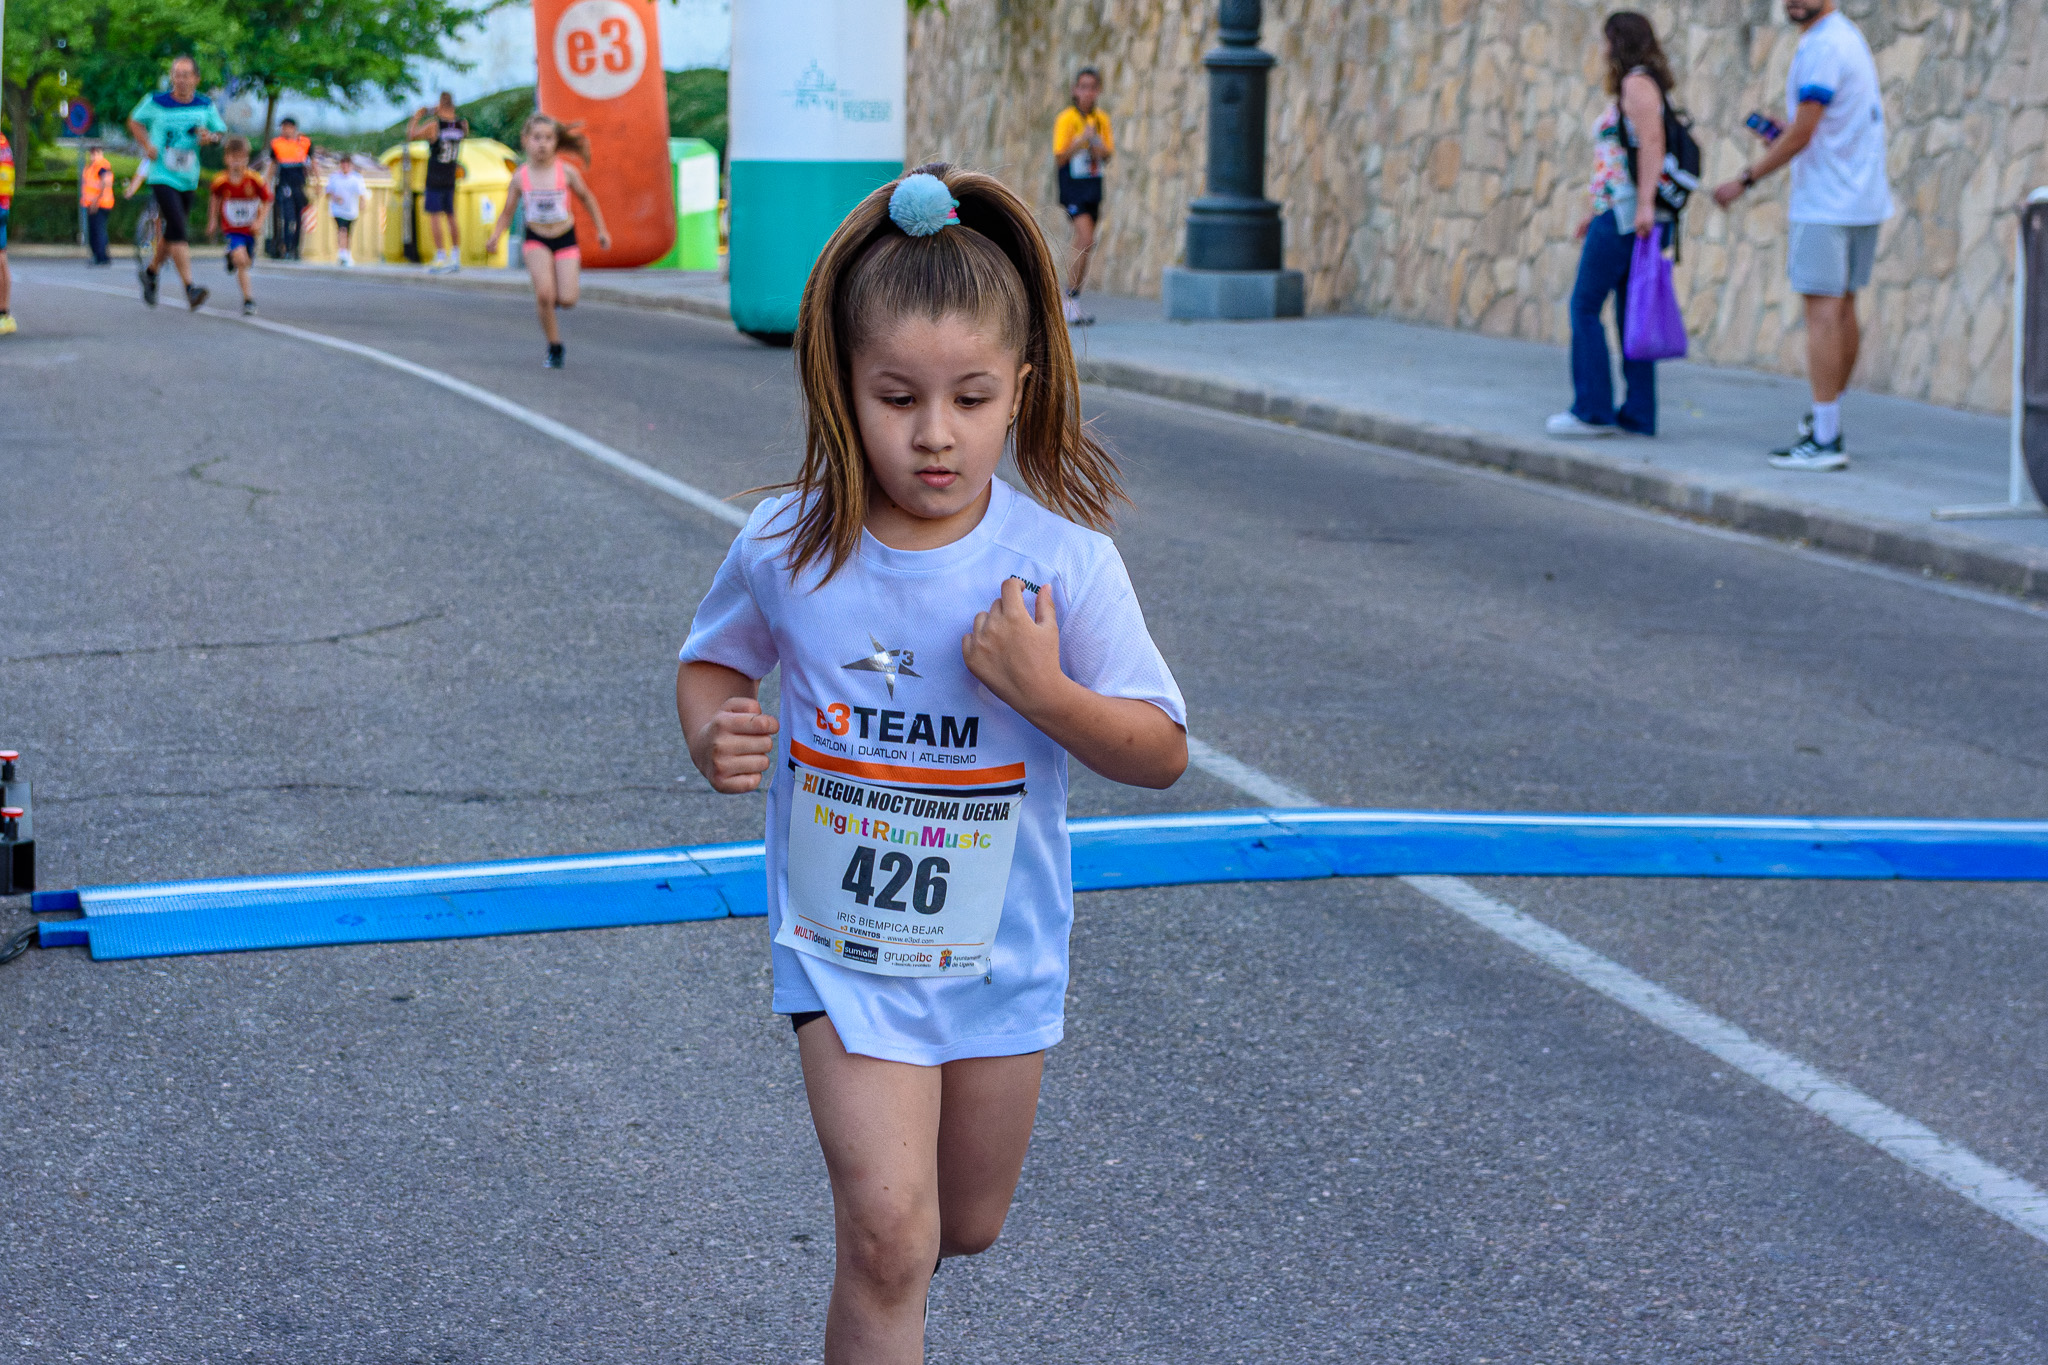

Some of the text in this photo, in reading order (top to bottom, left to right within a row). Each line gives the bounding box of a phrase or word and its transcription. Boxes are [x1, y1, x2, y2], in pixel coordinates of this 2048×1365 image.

[567, 17, 633, 75] e3
[813, 733, 977, 764] TRIATLON DUATLON ATLETISMO
[802, 773, 1010, 822] XI LEGUA NOCTURNA UGENA
[841, 845, 950, 915] 426
[837, 911, 944, 935] IRIS BIEMPICA BEJAR
[849, 927, 881, 939] EVENTOS
